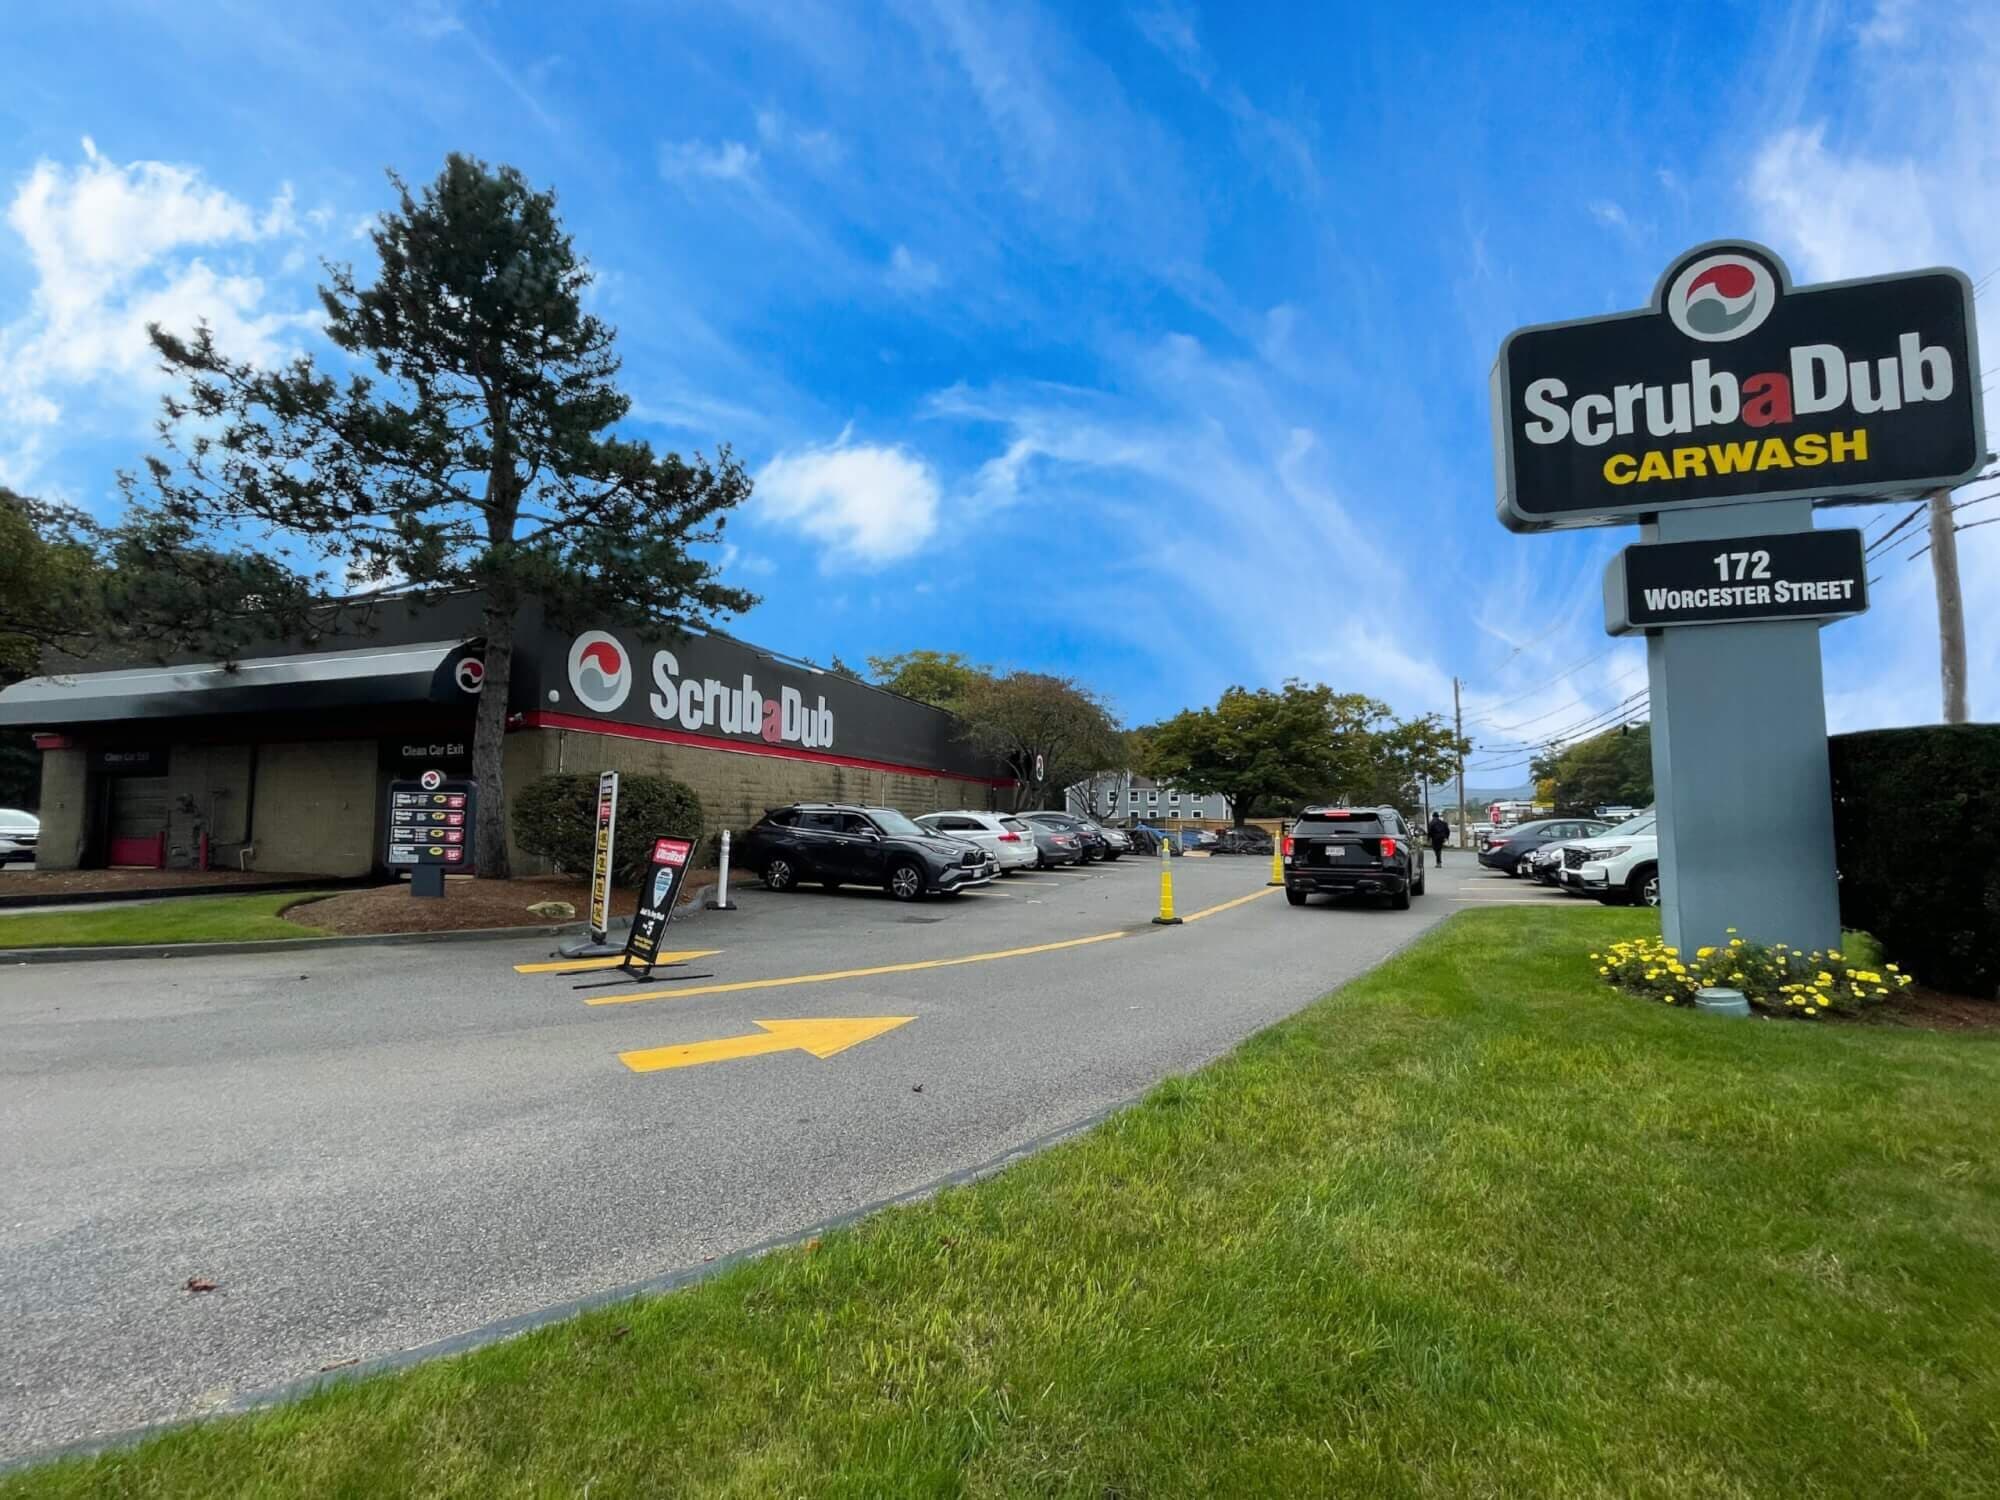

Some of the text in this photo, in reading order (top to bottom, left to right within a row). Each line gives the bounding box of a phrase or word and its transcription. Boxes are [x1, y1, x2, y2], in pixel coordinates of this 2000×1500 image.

[1524, 332, 1954, 446] ScrubaDub
[1603, 429, 1868, 485] CARWASH
[1713, 550, 1771, 582] 172
[1644, 579, 1854, 611] WORCESTER STREET
[650, 650, 834, 749] ScrubaDub
[429, 744, 444, 756] Car
[447, 743, 464, 755] Exit
